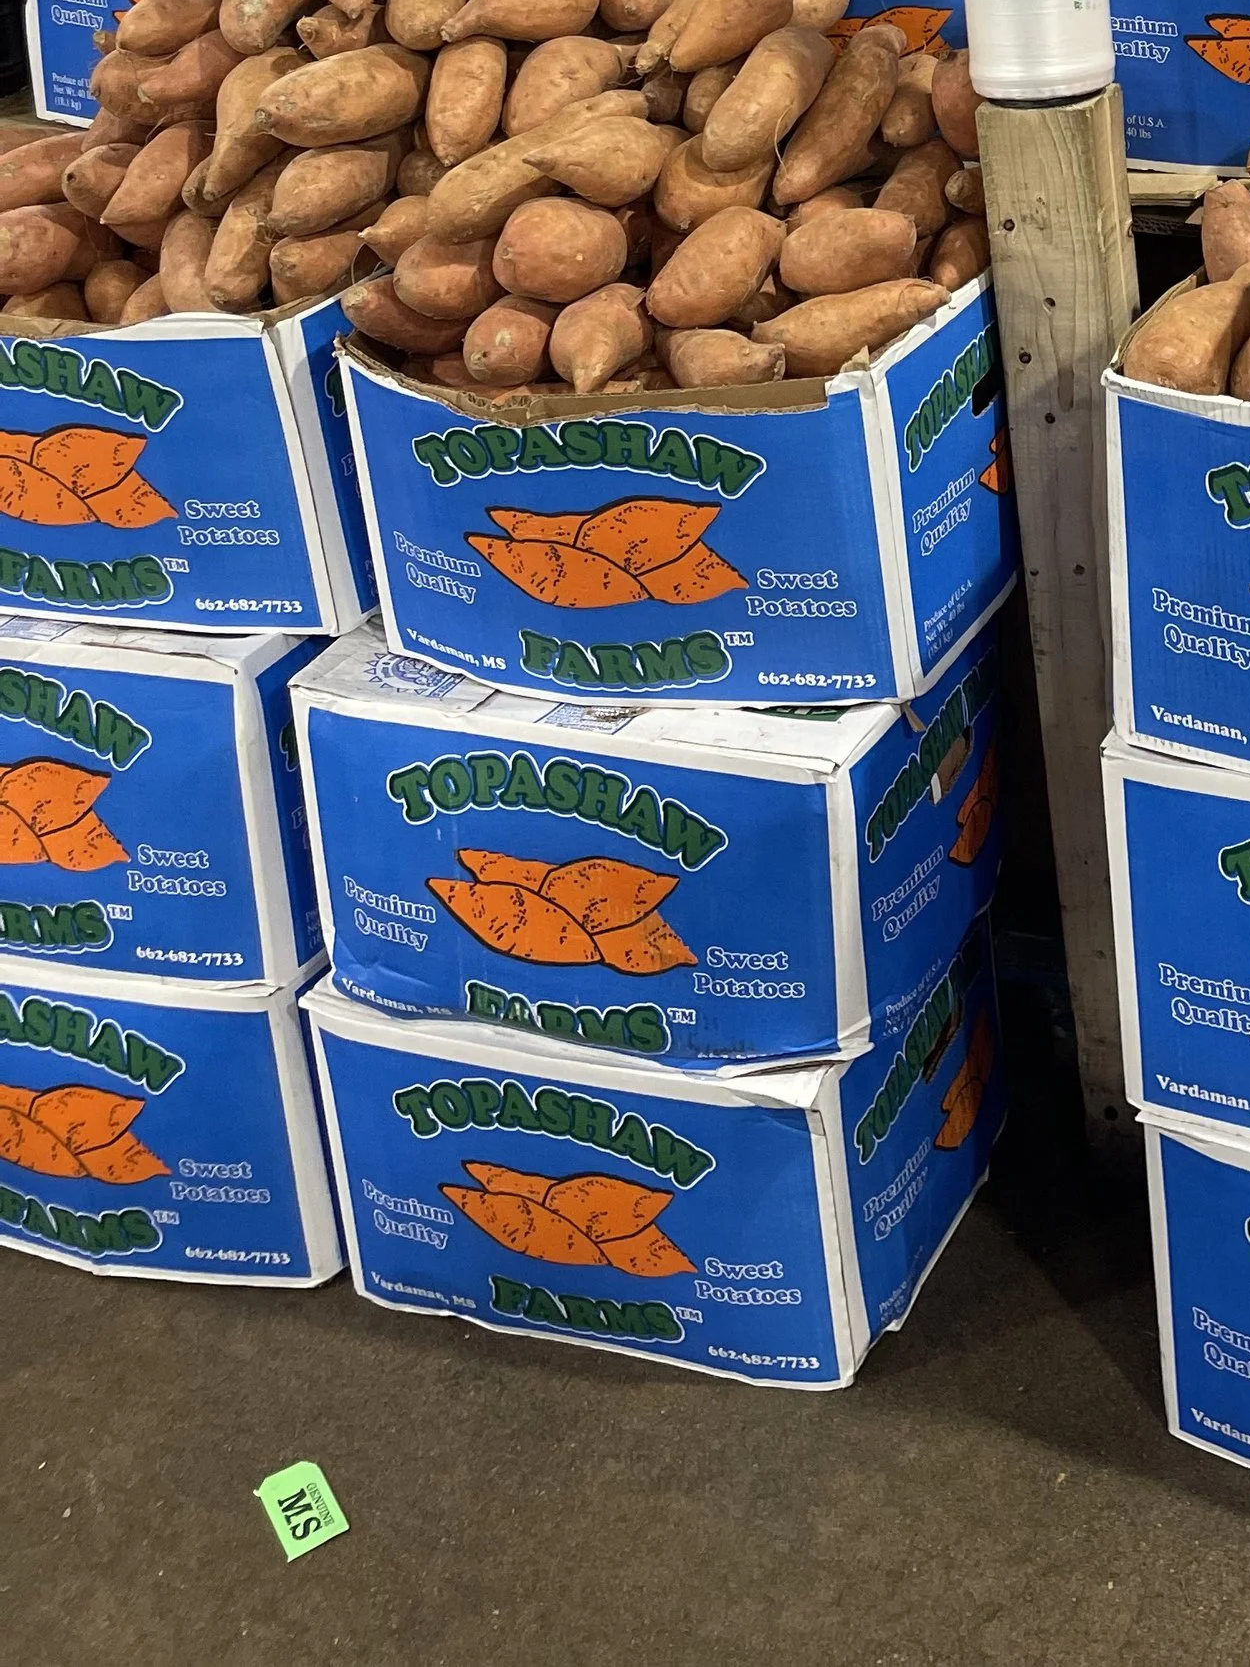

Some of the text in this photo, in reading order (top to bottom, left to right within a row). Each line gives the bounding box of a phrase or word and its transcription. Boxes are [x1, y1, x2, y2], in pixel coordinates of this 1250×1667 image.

[52, 5, 103, 30] Quality
[1111, 15, 1178, 37] emium
[1113, 40, 1170, 63] uality
[412, 420, 766, 499] TOPASHAW
[184, 500, 260, 519] Sweet
[912, 467, 975, 534] Premium
[178, 526, 280, 545] Potatoes
[921, 498, 971, 557] Quality
[393, 533, 481, 577] Premium
[406, 564, 476, 604] Quality
[756, 569, 839, 590] Sweet
[195, 598, 303, 613] 662-682-7733
[747, 597, 857, 618] Potatoes
[406, 628, 507, 671] Vardaman, MS
[518, 629, 732, 691] FARMS
[758, 671, 876, 688] 662-682-7733
[1150, 705, 1248, 745] Vardaman,
[386, 749, 728, 871] TOPASHAW
[138, 844, 209, 869] Sweet
[127, 871, 226, 897] Potatoes
[343, 877, 436, 923] Premium
[353, 909, 429, 951] Quality
[136, 947, 243, 966] 662-682-7733
[706, 947, 788, 970] Sweet
[693, 972, 805, 999] Potatoes
[464, 980, 672, 1052] FARMS
[392, 1078, 716, 1189] TOPASHAW
[179, 1158, 253, 1179] Sweet
[170, 1181, 271, 1203] Potatoes
[361, 1179, 454, 1226] Premium
[373, 1209, 449, 1250] Quality
[185, 1247, 291, 1264] 662-682-7733
[705, 1258, 784, 1280] Sweet
[370, 1272, 449, 1305] Vardaman,
[694, 1280, 801, 1305] Potatoes
[489, 1276, 685, 1343] FARMS
[708, 1345, 820, 1371] 662-682-7733
[277, 1488, 322, 1541] MS
[306, 1482, 335, 1527] GENUINE
